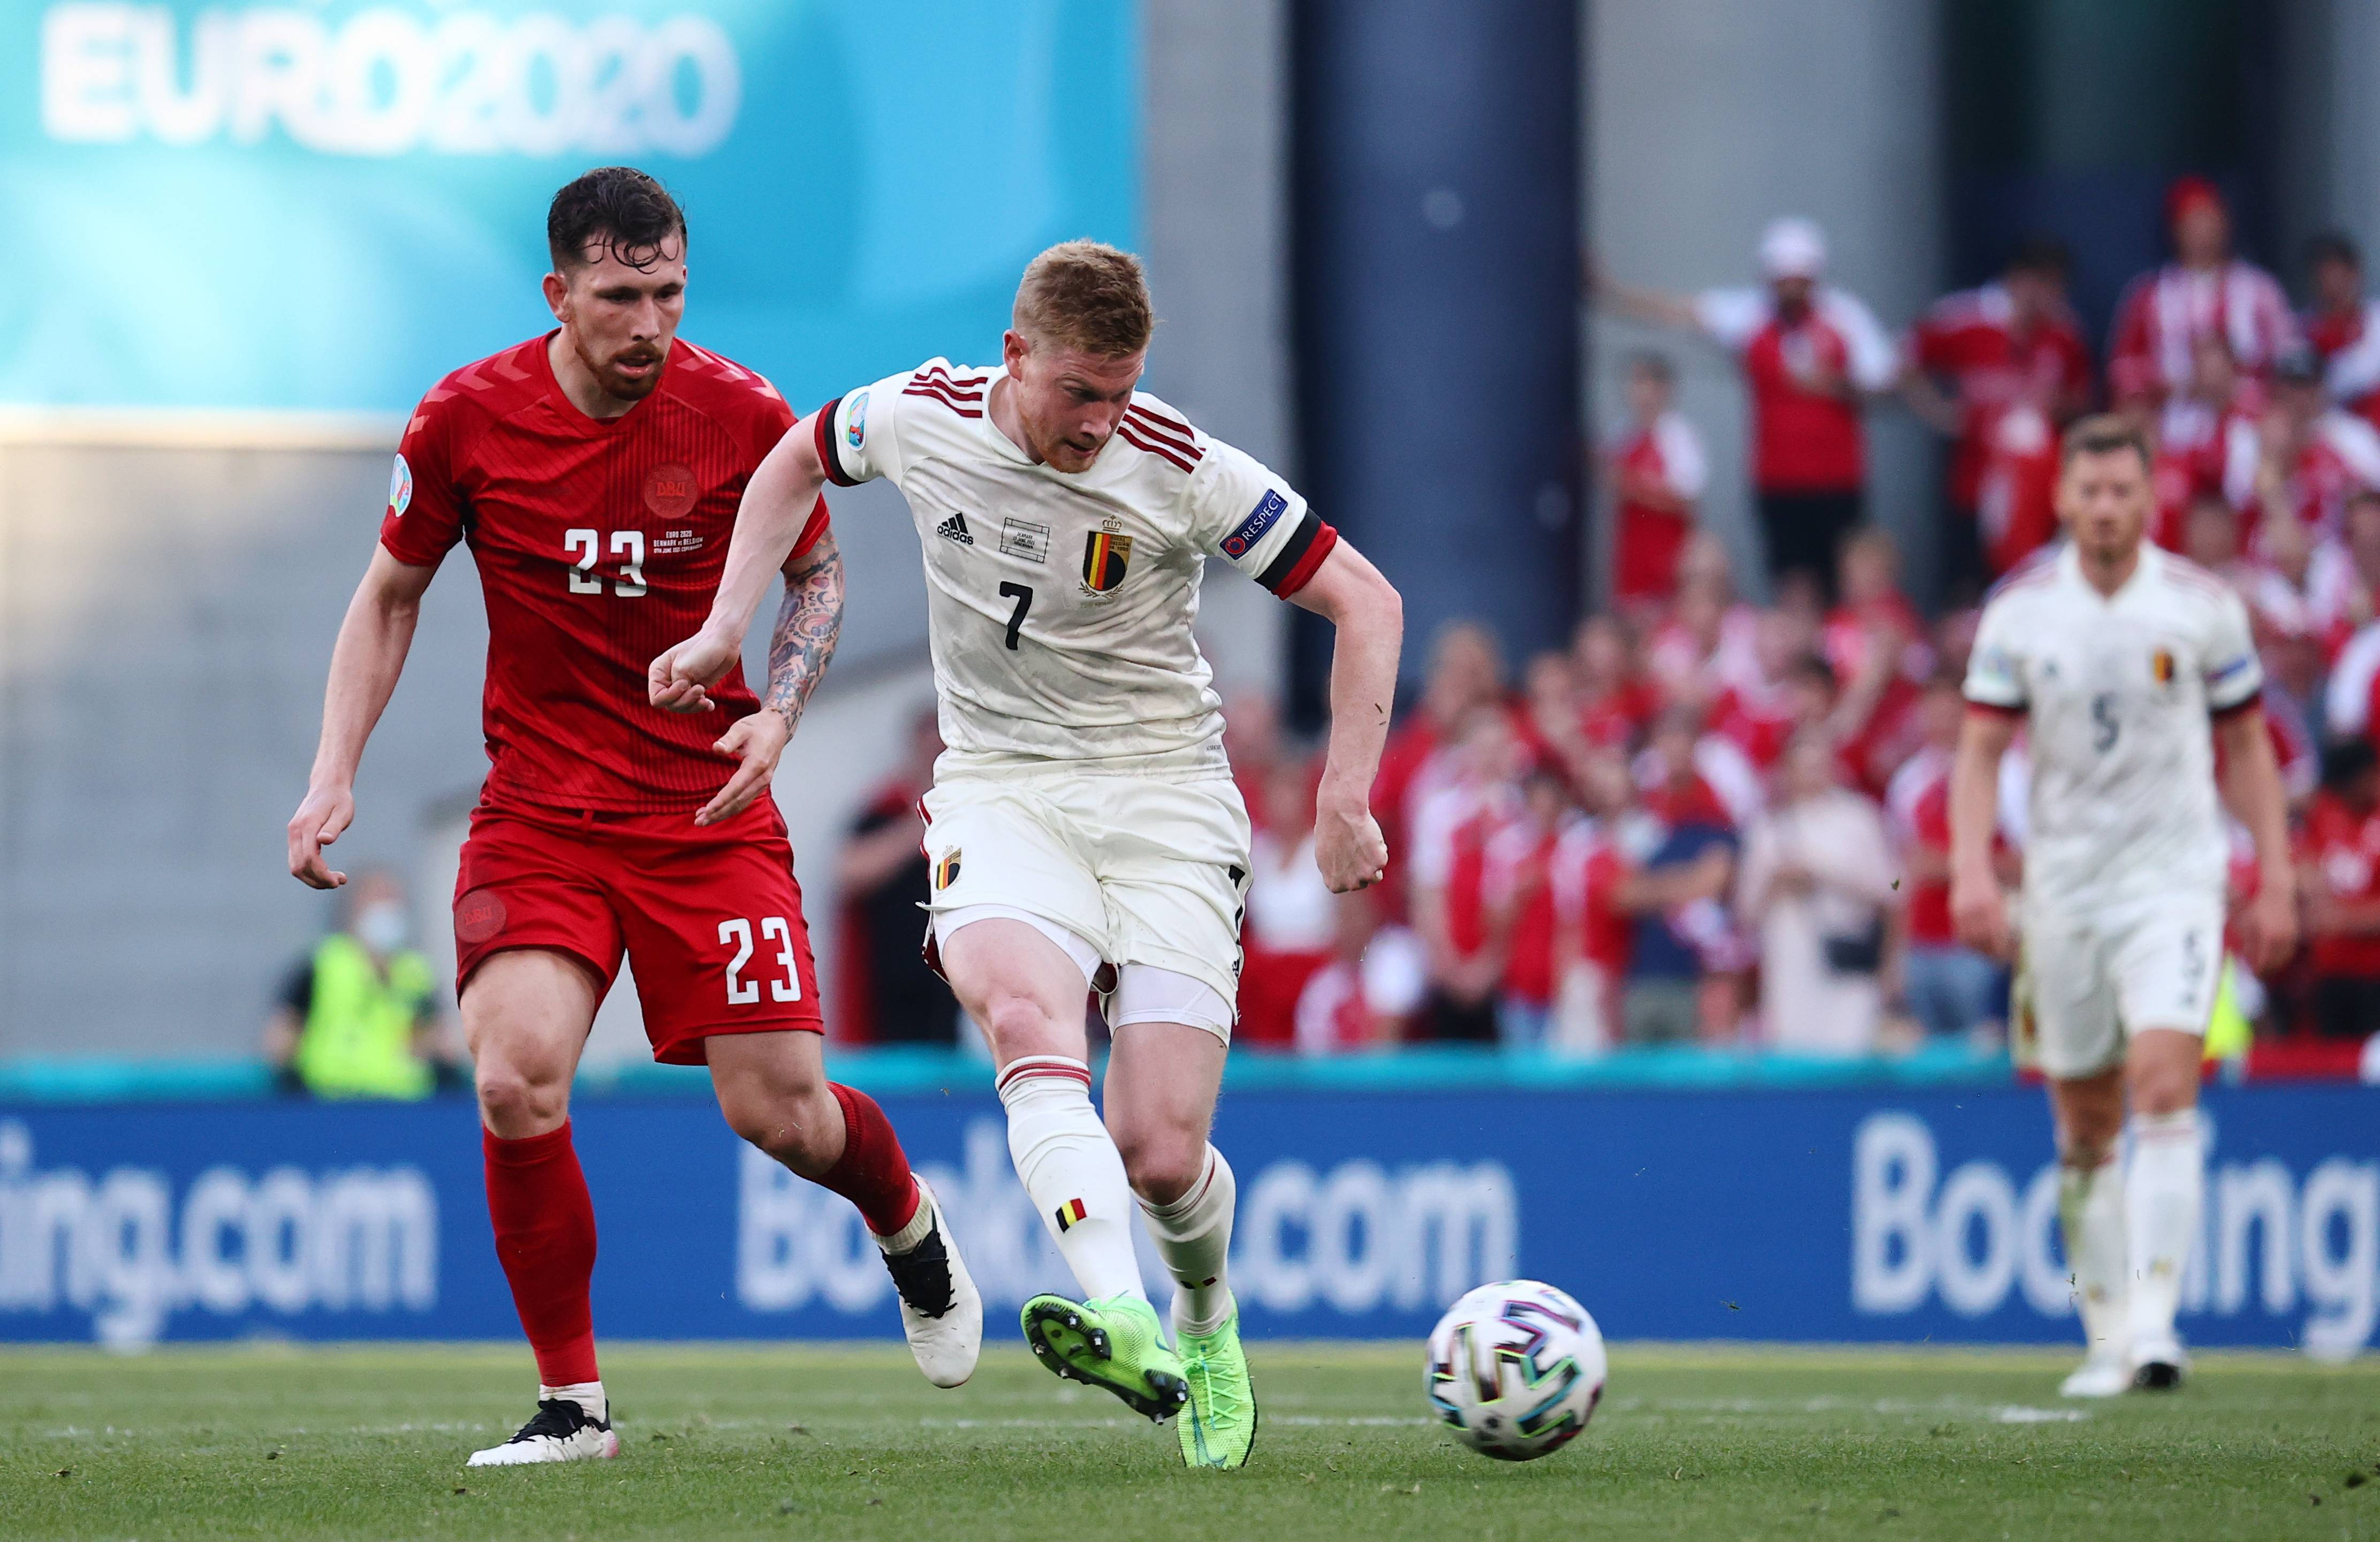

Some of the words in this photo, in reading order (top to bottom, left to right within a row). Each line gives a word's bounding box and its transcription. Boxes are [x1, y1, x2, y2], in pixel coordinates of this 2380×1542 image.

[653, 539, 677, 547] DENMARK
[937, 525, 974, 545] adidas
[1241, 493, 1282, 541] RESPECT
[564, 528, 647, 597] 23
[999, 581, 1033, 651] 7
[2092, 692, 2120, 756] 5
[718, 916, 802, 1005] 23
[1852, 1109, 2380, 1361] Booing
